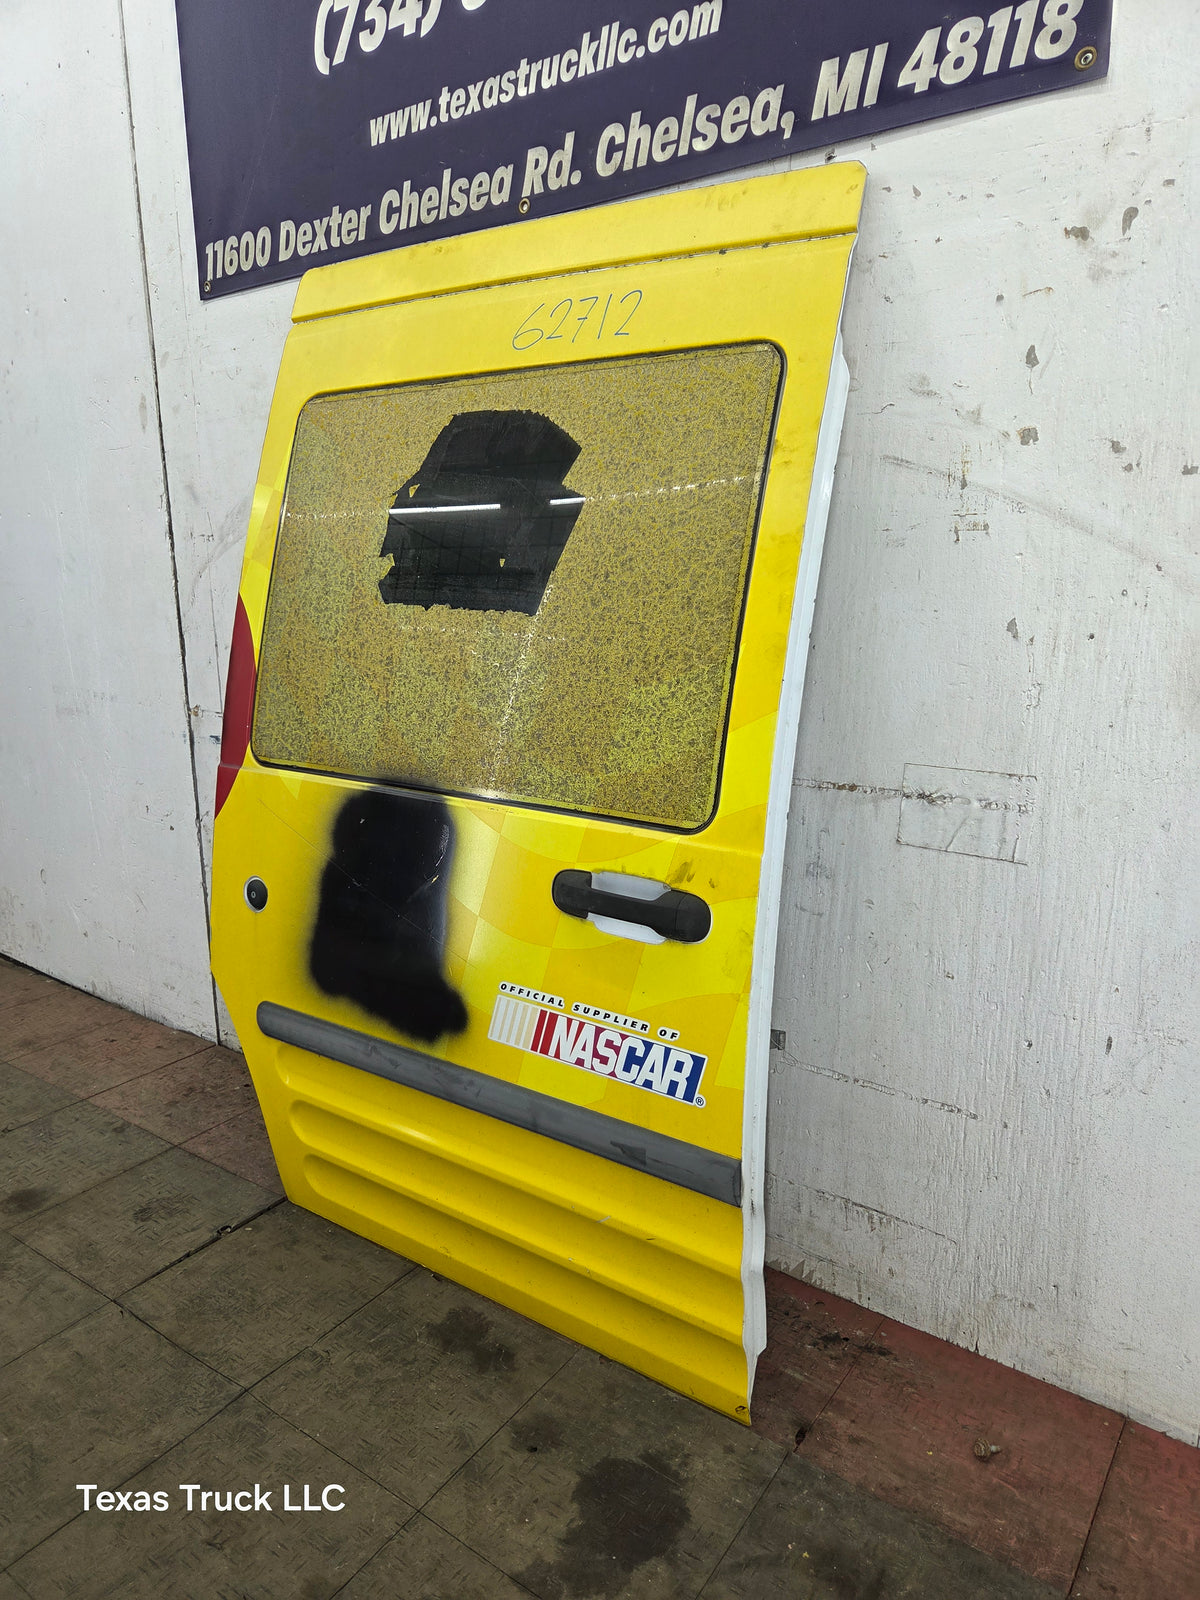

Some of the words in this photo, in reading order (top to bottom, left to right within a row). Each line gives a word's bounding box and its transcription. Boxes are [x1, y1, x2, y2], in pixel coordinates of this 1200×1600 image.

[369, 0, 722, 147] www.texastruckllc.com
[205, 227, 272, 282] 11600
[278, 204, 371, 262] Dexter
[379, 163, 515, 236] Chelsea
[520, 132, 582, 198] Rd.
[595, 82, 795, 178] Chelsea,
[811, 42, 890, 122] MI
[897, 0, 1085, 94] 48118
[512, 289, 643, 351] 62712
[500, 982, 565, 1008] OFFICIAL
[573, 1004, 649, 1032] SUPPLIER
[659, 1028, 679, 1040] OF
[548, 1014, 694, 1099] NASCAR
